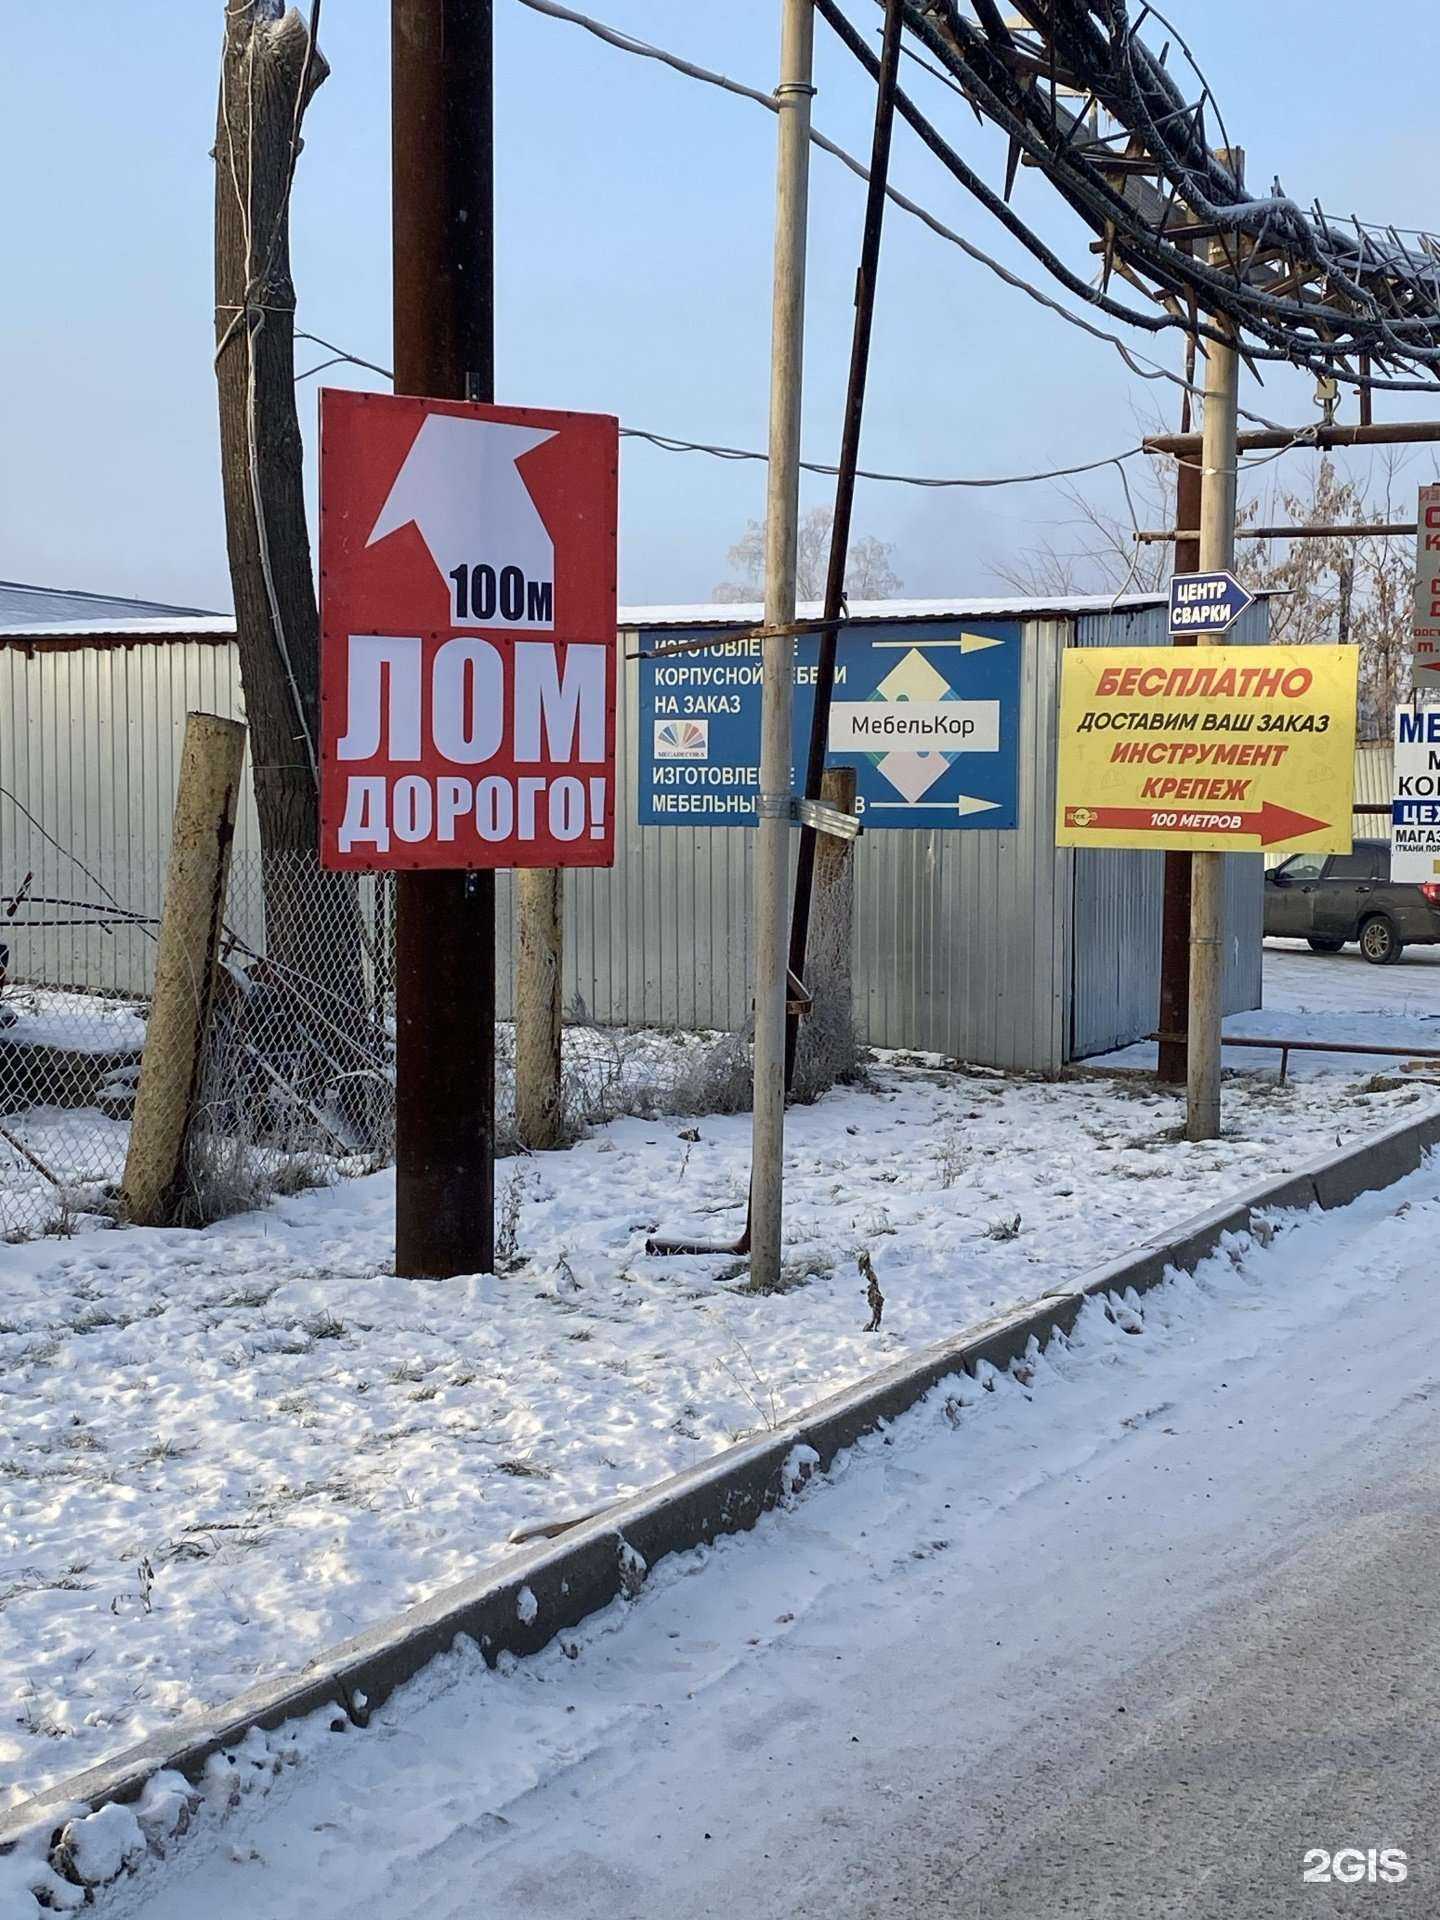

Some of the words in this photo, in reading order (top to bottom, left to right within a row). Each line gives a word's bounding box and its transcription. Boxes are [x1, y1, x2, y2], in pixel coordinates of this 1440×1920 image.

[450, 563, 552, 621] 100м
[1177, 581, 1227, 604] ЦЕНТР
[1172, 604, 1232, 625] СВАРКИ
[655, 662, 764, 686] КОРПУСНОЙ
[792, 666, 847, 684] БЕИ
[1095, 667, 1314, 698] БЕСПЛАТНО
[337, 635, 606, 764] ЛОМ
[654, 695, 679, 714] НА
[683, 695, 741, 714] ЗАКАЗ
[852, 716, 975, 738] МебельКор
[1076, 712, 1199, 733] ДОСТАВИМ
[1201, 713, 1254, 732] ВАШ
[1256, 714, 1330, 733] ЗАКАЗ
[1109, 742, 1289, 767] ИНСТРУМЕНТ
[653, 767, 796, 785] ИЗГОТОВЛЕ
[1399, 776, 1440, 796] КО
[1140, 777, 1252, 800] КРЕПЕЖ
[338, 775, 606, 853] ДОРОГО!
[652, 794, 762, 814] МЕБЕЛЬНЫ
[1150, 813, 1176, 827] 100
[1179, 814, 1242, 828] МЕТРОВ
